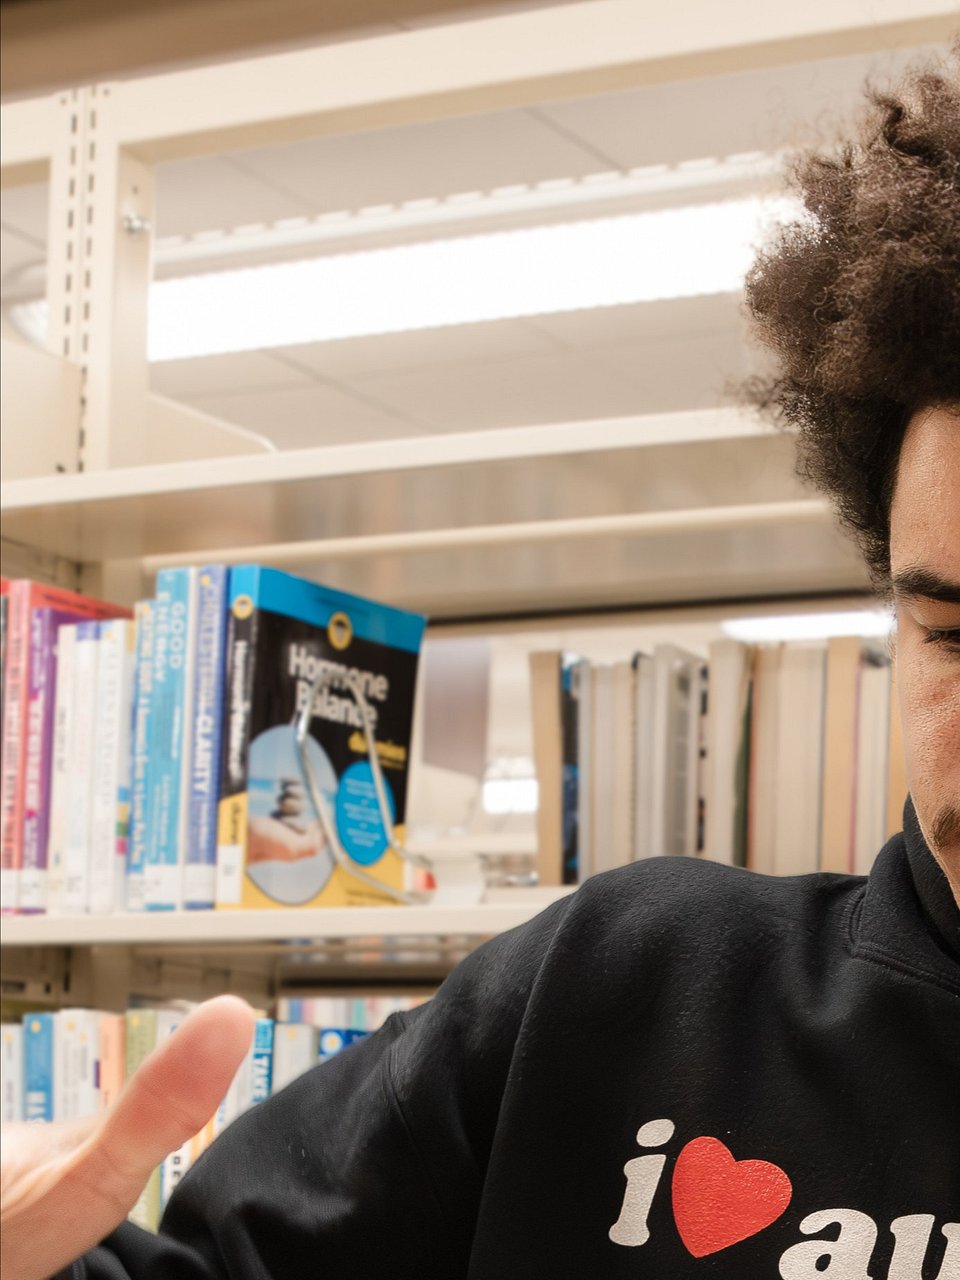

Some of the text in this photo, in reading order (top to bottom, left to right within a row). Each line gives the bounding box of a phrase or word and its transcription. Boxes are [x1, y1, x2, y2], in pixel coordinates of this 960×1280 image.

[153, 590, 172, 683] ENERGY
[169, 600, 186, 670] GOOD
[194, 714, 215, 794] CLARITY
[252, 1056, 269, 1098] TAKE
[608, 1118, 675, 1247] i
